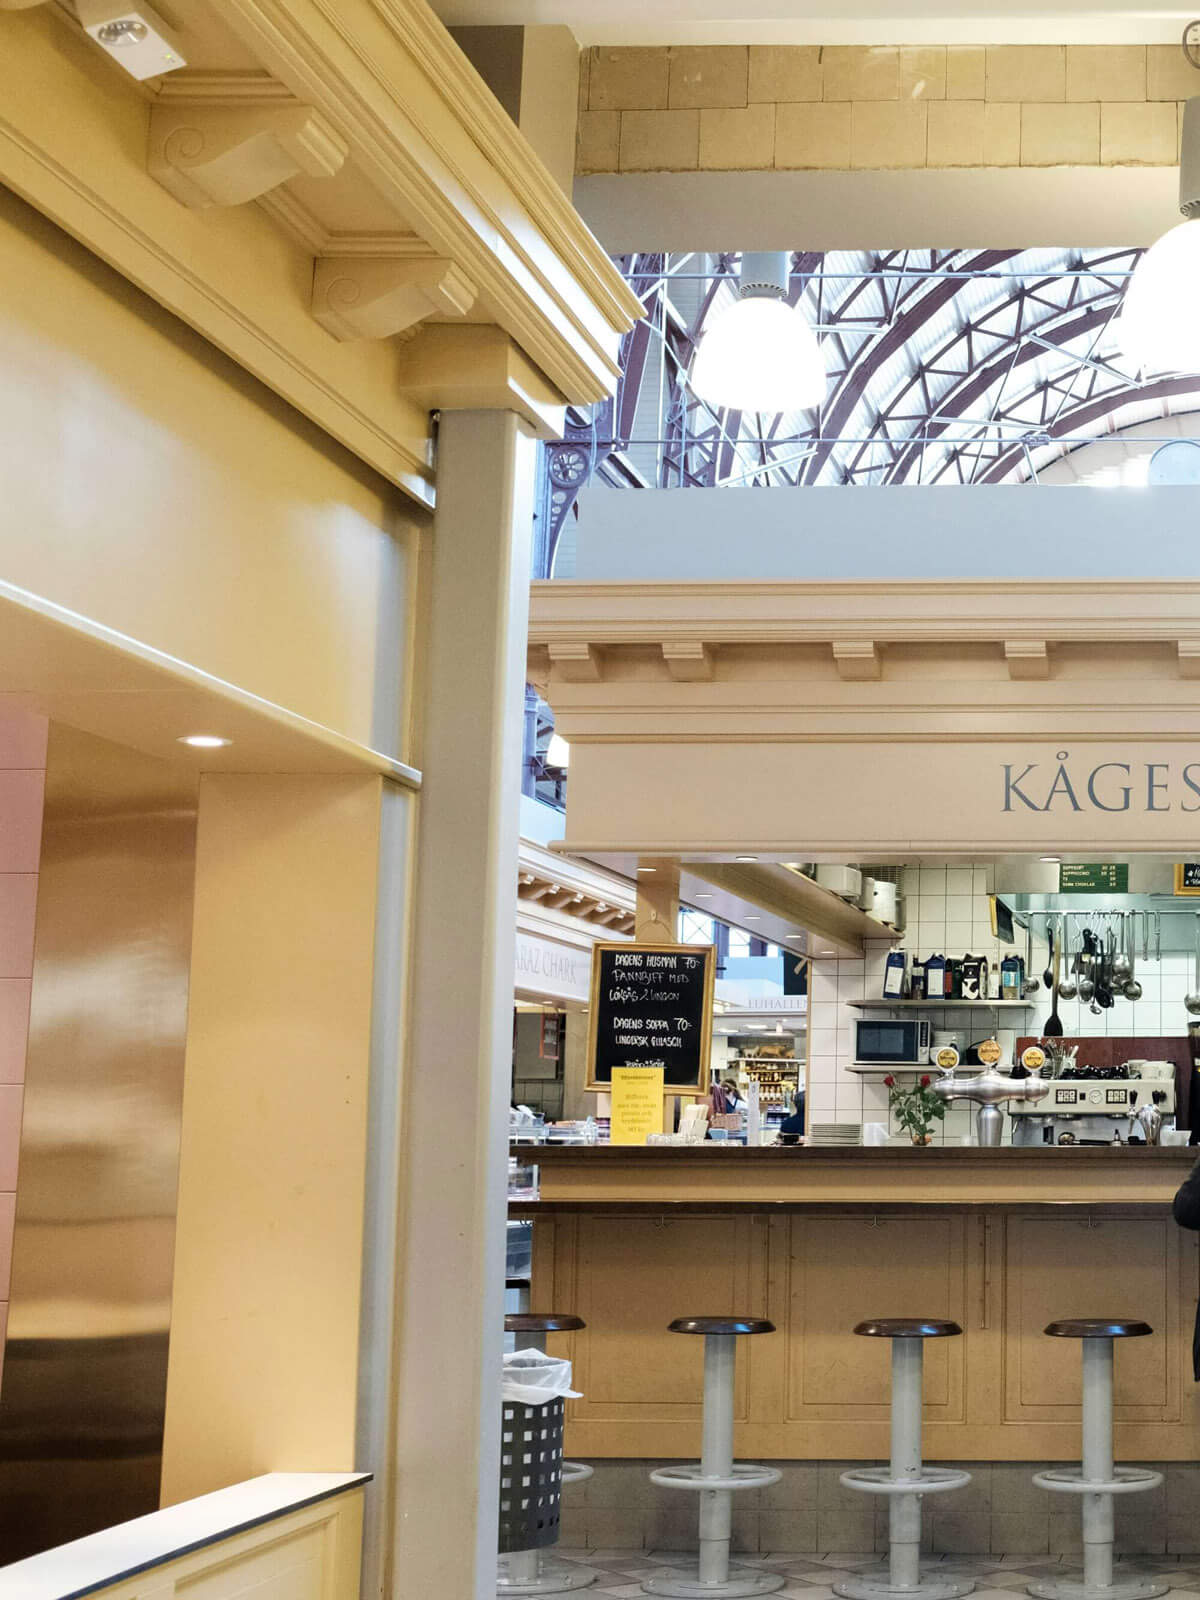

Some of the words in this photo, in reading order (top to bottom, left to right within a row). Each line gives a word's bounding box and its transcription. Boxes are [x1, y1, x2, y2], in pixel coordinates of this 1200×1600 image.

[542, 951, 577, 984] CHARK
[615, 954, 643, 967] DAGENS
[646, 955, 677, 969] HUSMAN
[611, 968, 665, 985] PANNBIFF
[613, 1016, 643, 1030] DAGENS
[645, 1018, 670, 1031] SOPPA
